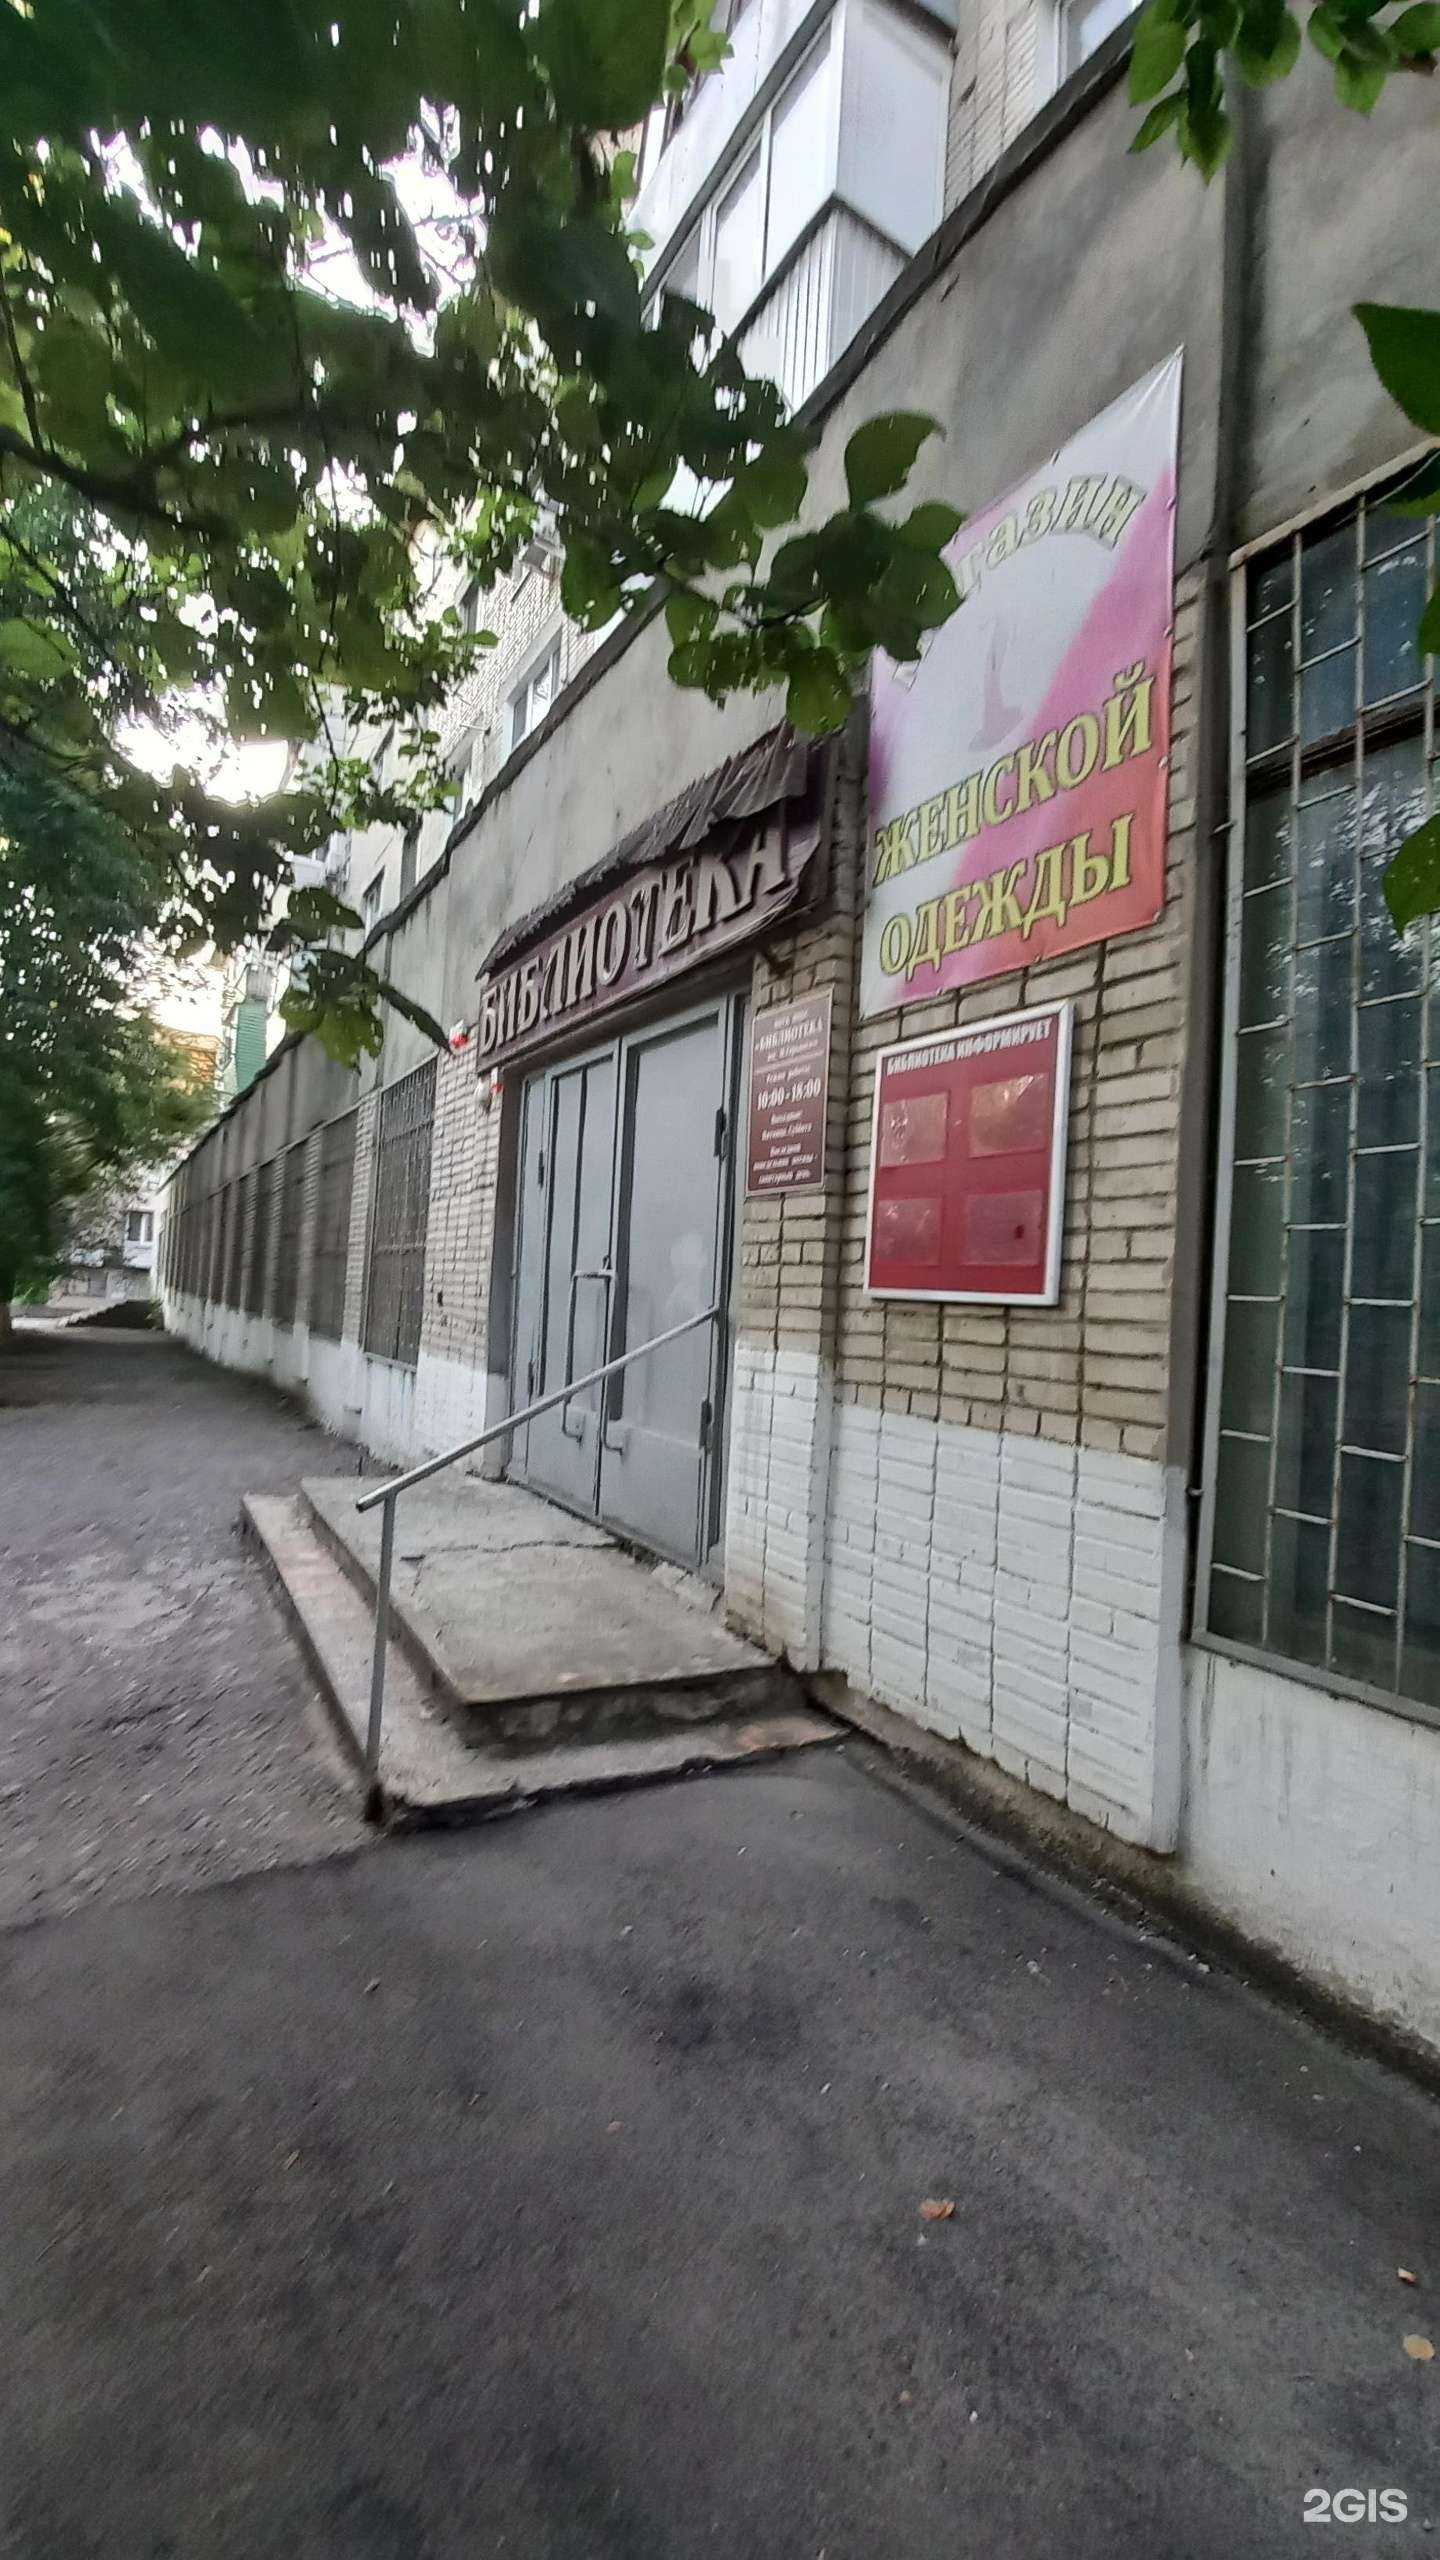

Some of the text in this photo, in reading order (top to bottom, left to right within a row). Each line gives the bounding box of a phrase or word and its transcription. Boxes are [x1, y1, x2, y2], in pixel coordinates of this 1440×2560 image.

[873, 665, 1154, 888] ЖЕНСКОЙ
[480, 827, 787, 1056] БИБЛИОТЕКА
[879, 813, 1135, 981] ОДЕЖДЫ
[887, 1018, 1053, 1075] БИБЛИОТЕКА ИНФОРМИРУЕТ
